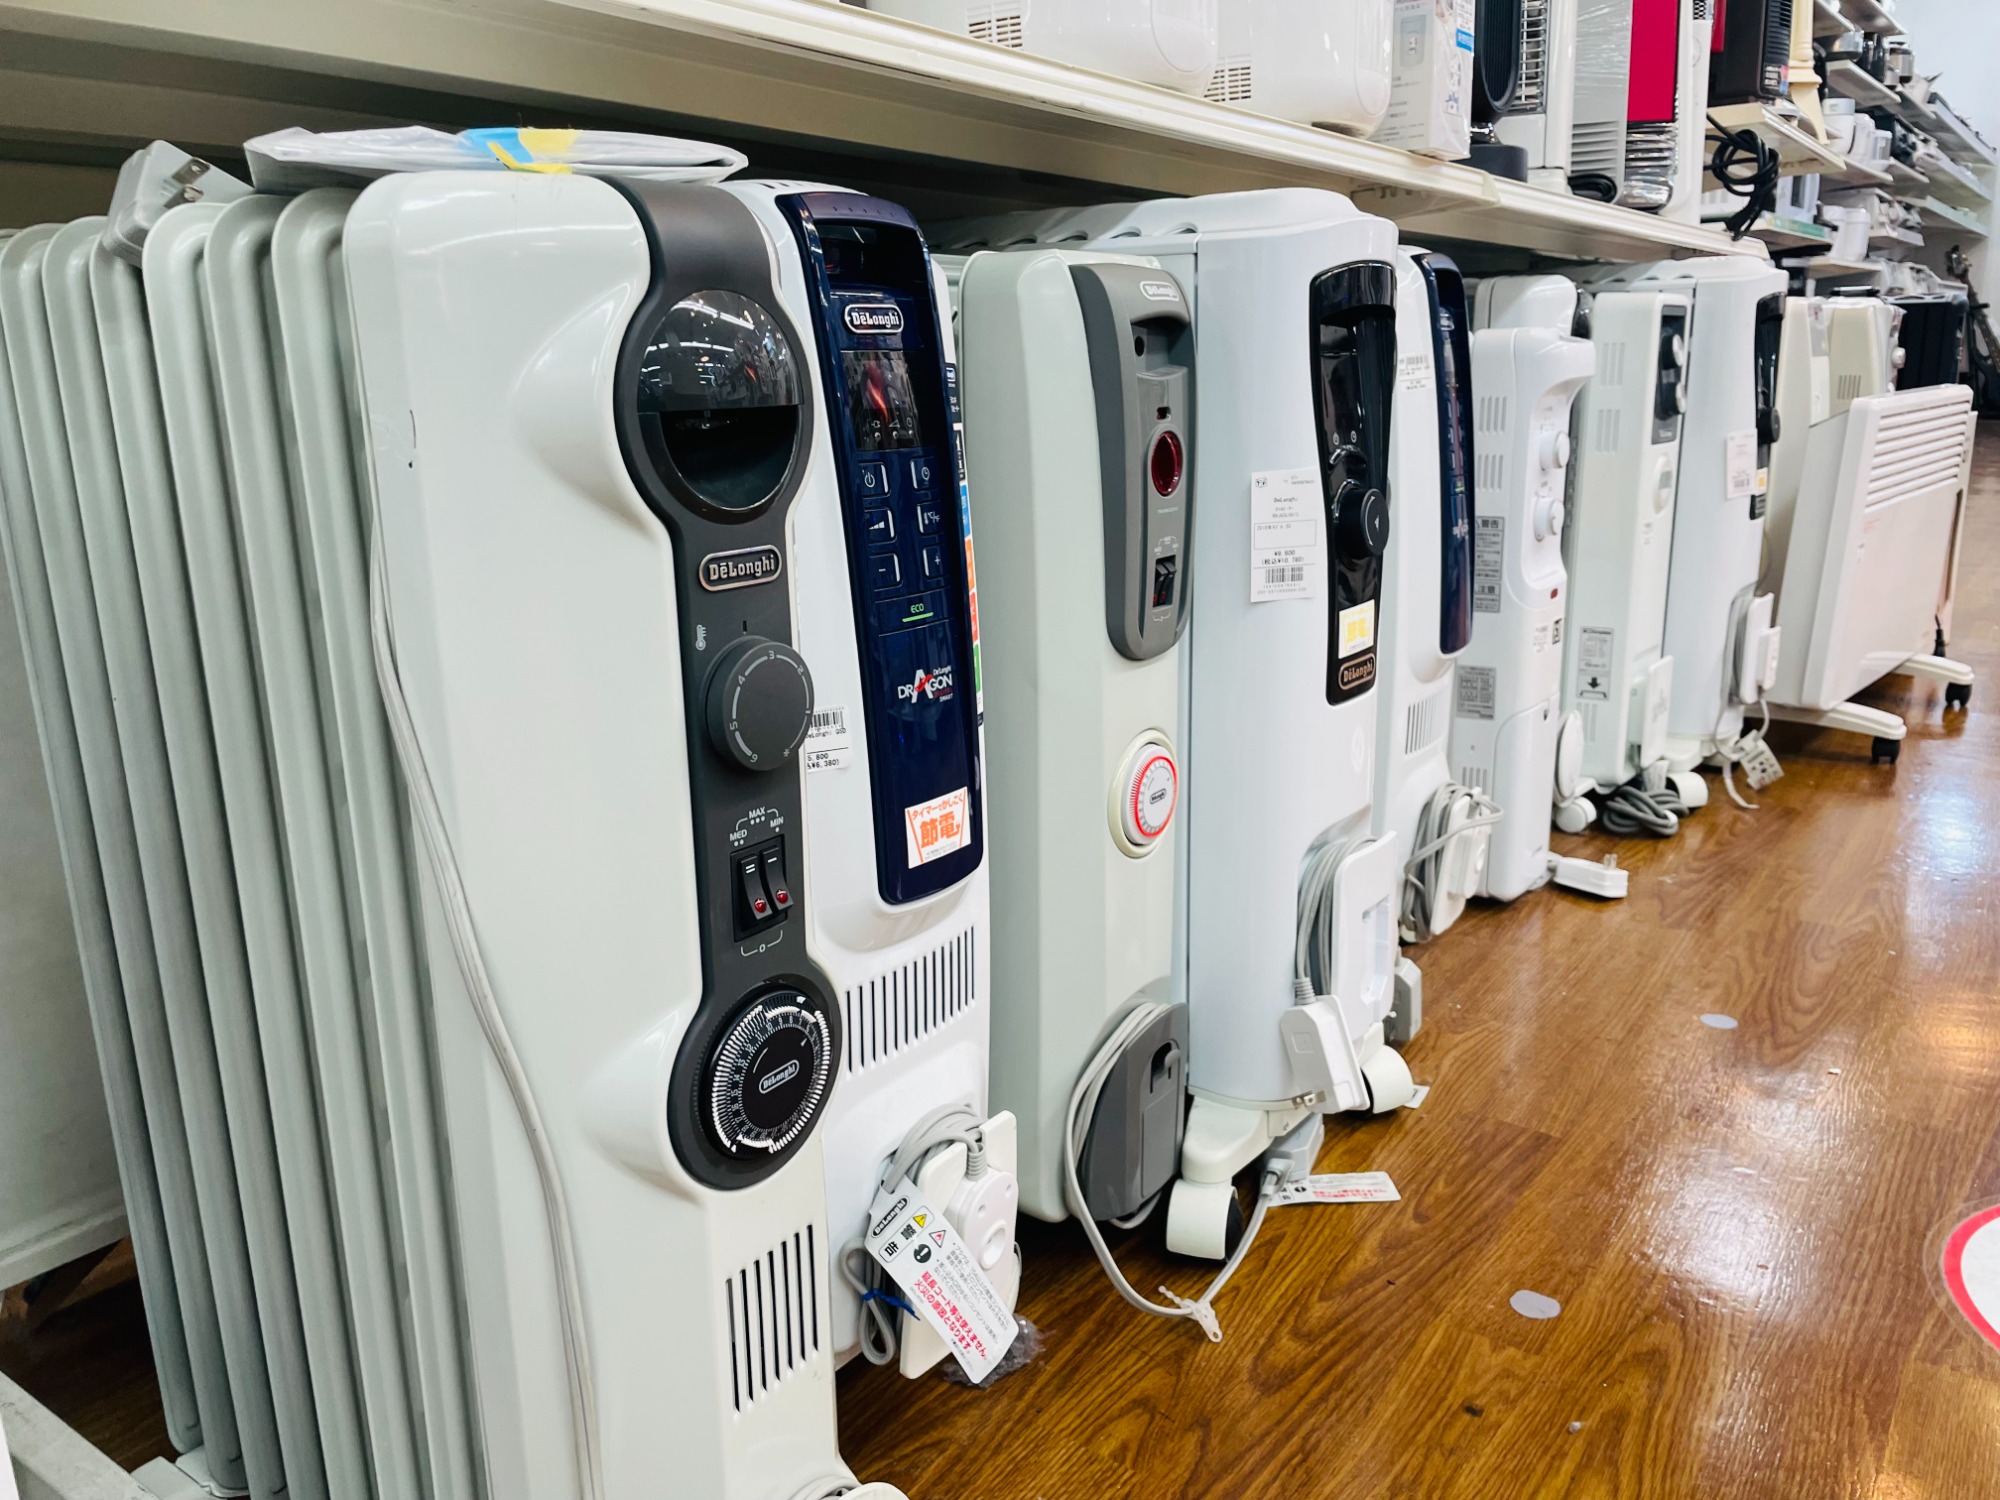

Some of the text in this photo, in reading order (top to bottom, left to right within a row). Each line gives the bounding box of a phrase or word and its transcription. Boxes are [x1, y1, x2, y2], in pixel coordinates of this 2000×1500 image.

[910, 603, 925, 613] ECO
[729, 721, 738, 731] 5
[738, 675, 746, 685] 4
[768, 650, 775, 660] 3
[797, 664, 804, 675] 2
[897, 669, 953, 704] DRAGON
[748, 806, 766, 820] MAX
[770, 816, 784, 829] MIN
[920, 811, 961, 849] 節電
[729, 829, 748, 842] MED
[914, 1278, 972, 1354] 火災の原因となります。
[921, 1271, 987, 1361] 延長コード等は使えません。
